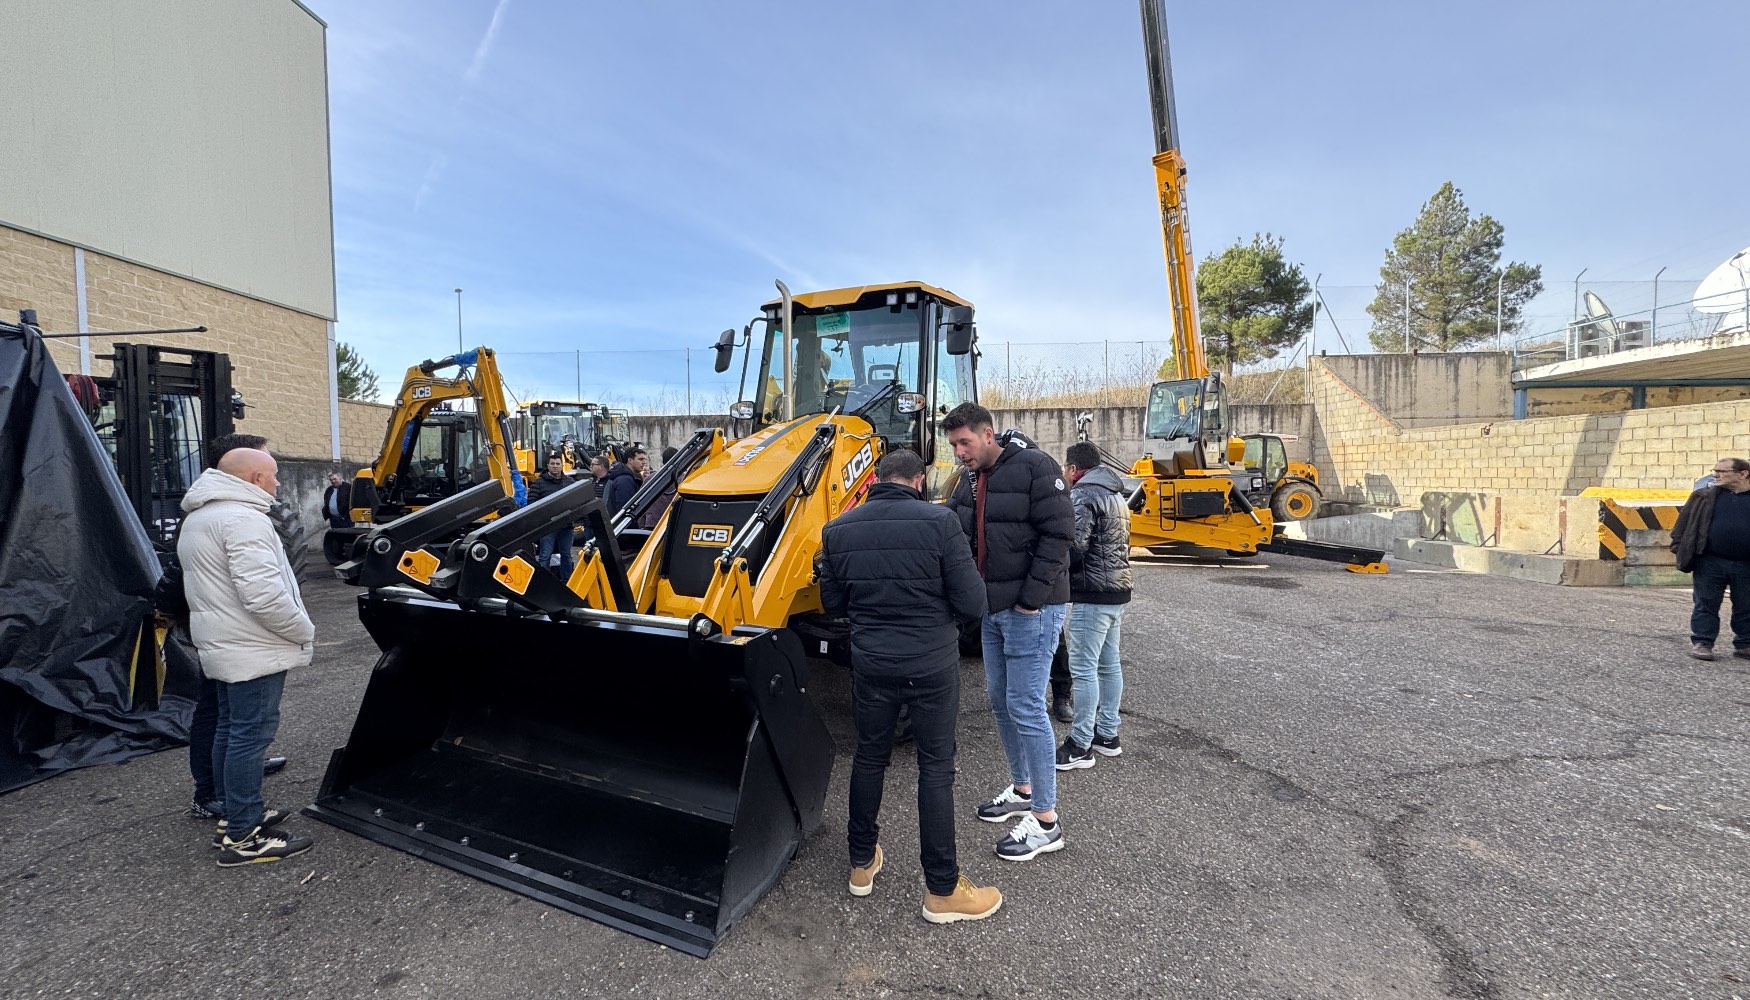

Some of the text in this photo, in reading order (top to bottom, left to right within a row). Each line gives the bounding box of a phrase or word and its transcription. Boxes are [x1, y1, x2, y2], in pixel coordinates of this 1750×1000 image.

[412, 386, 431, 399] JCB
[843, 443, 872, 489] JCB
[692, 529, 728, 542] JCB
